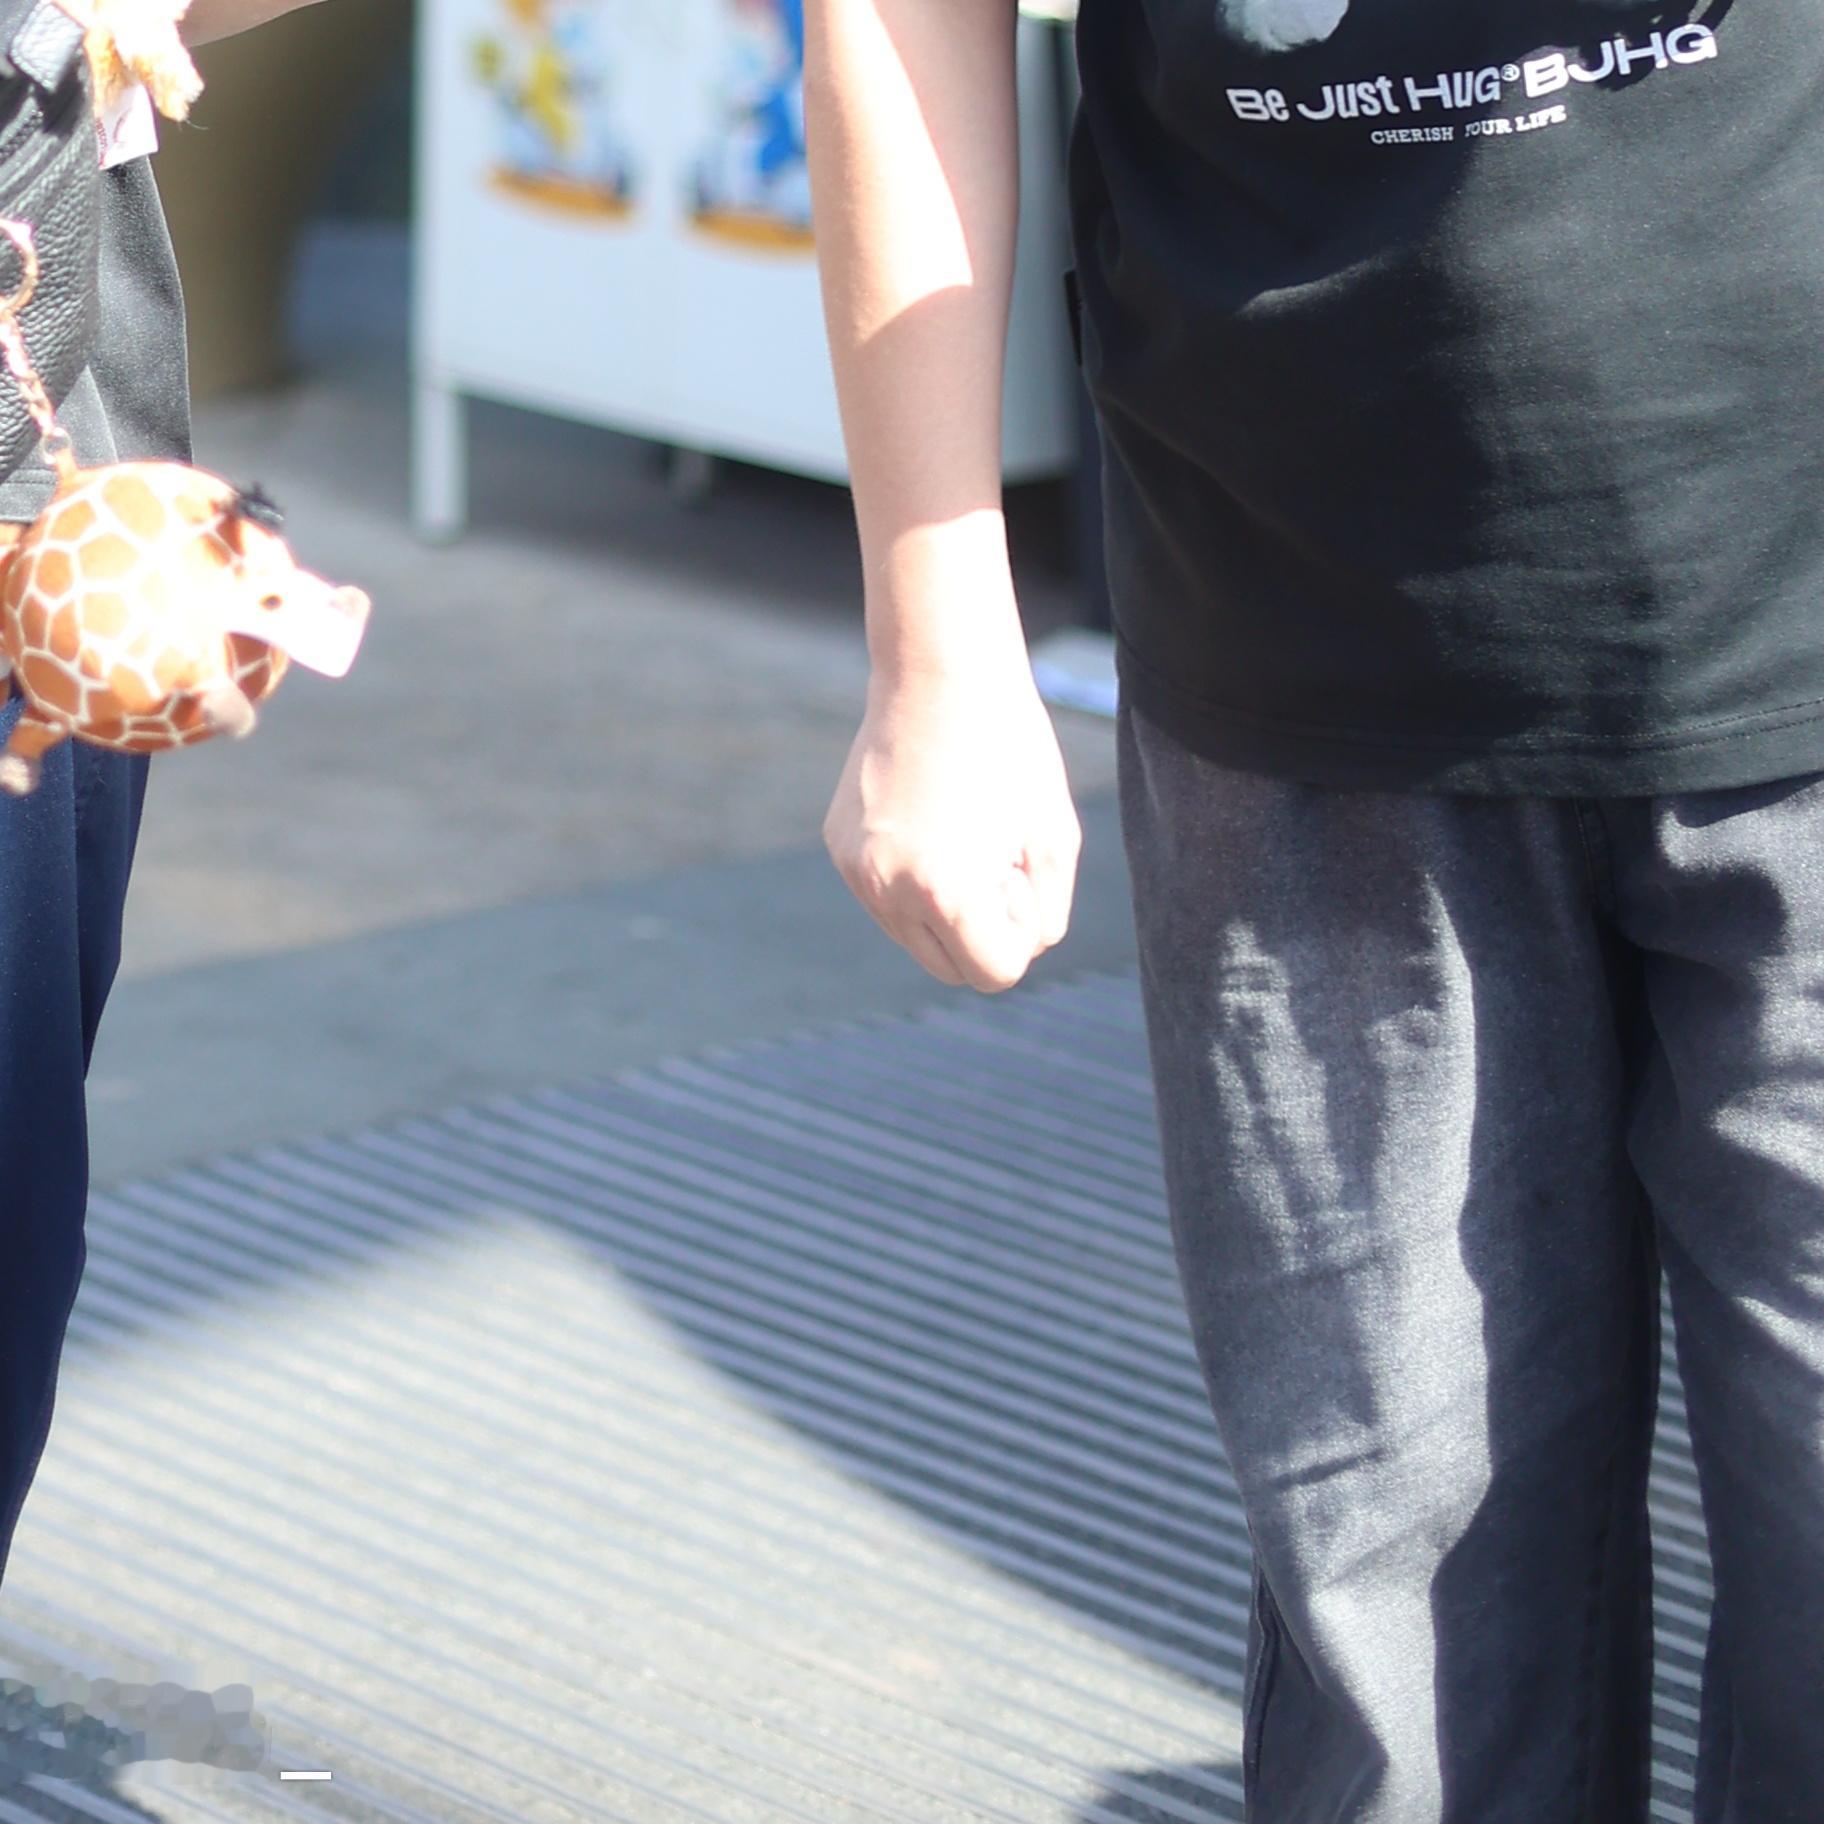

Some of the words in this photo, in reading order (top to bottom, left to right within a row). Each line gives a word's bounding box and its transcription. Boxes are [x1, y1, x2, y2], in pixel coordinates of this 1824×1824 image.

[1226, 88, 1290, 122] Be
[1523, 23, 1718, 98] BJHG
[1370, 126, 1454, 144] CHERISH
[1515, 104, 1567, 132] LIFE
